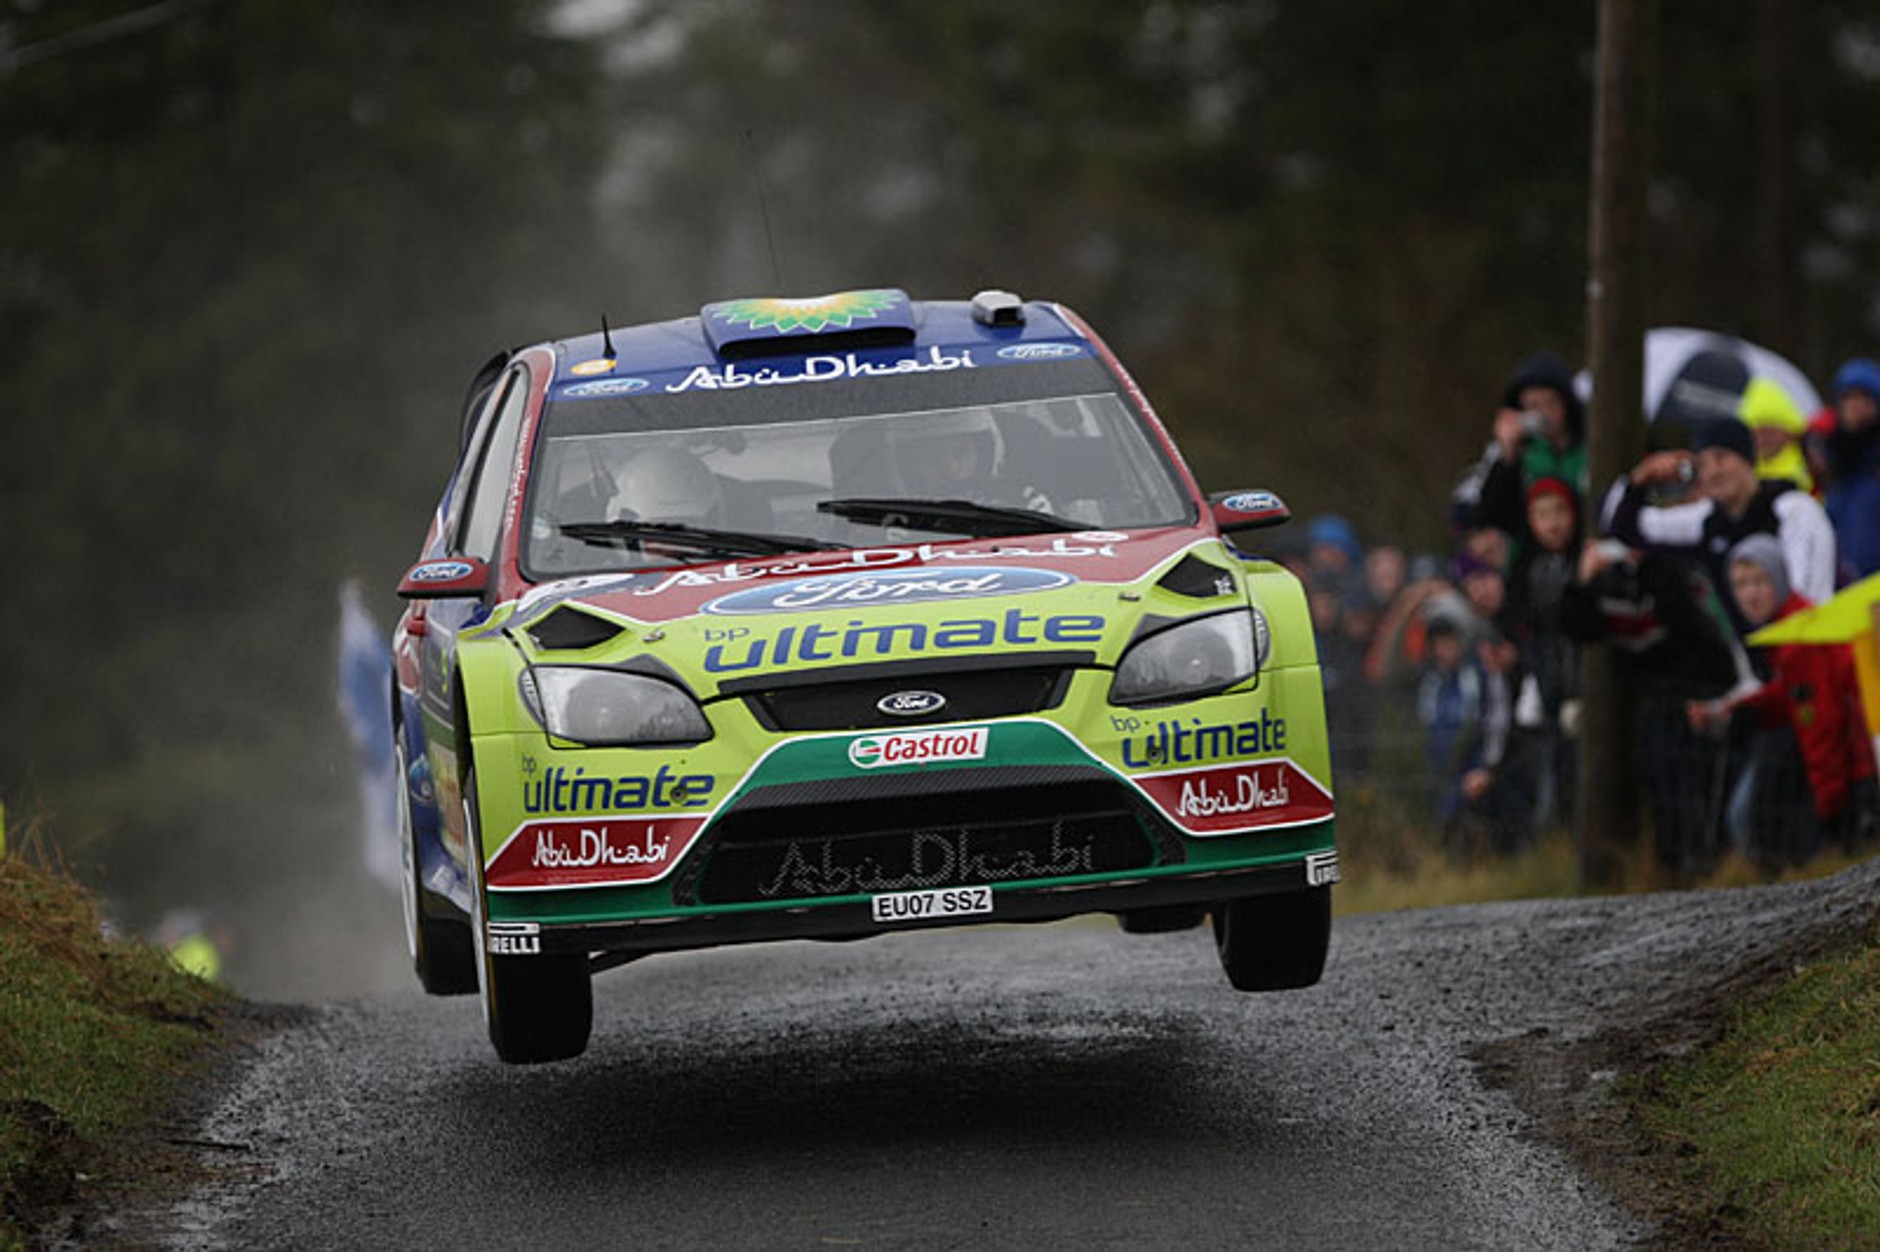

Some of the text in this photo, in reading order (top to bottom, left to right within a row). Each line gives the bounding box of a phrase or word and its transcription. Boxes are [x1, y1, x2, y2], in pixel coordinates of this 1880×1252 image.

[772, 570, 1003, 608] Ford
[703, 608, 1106, 673] ultimate
[704, 627, 751, 643] bp
[891, 694, 931, 710] Ford
[1109, 714, 1142, 733] bp
[1122, 706, 1287, 768] ultimate
[883, 732, 979, 762] Castrol
[523, 764, 716, 813] ultimate
[876, 890, 988, 918] EU07 SSZ
